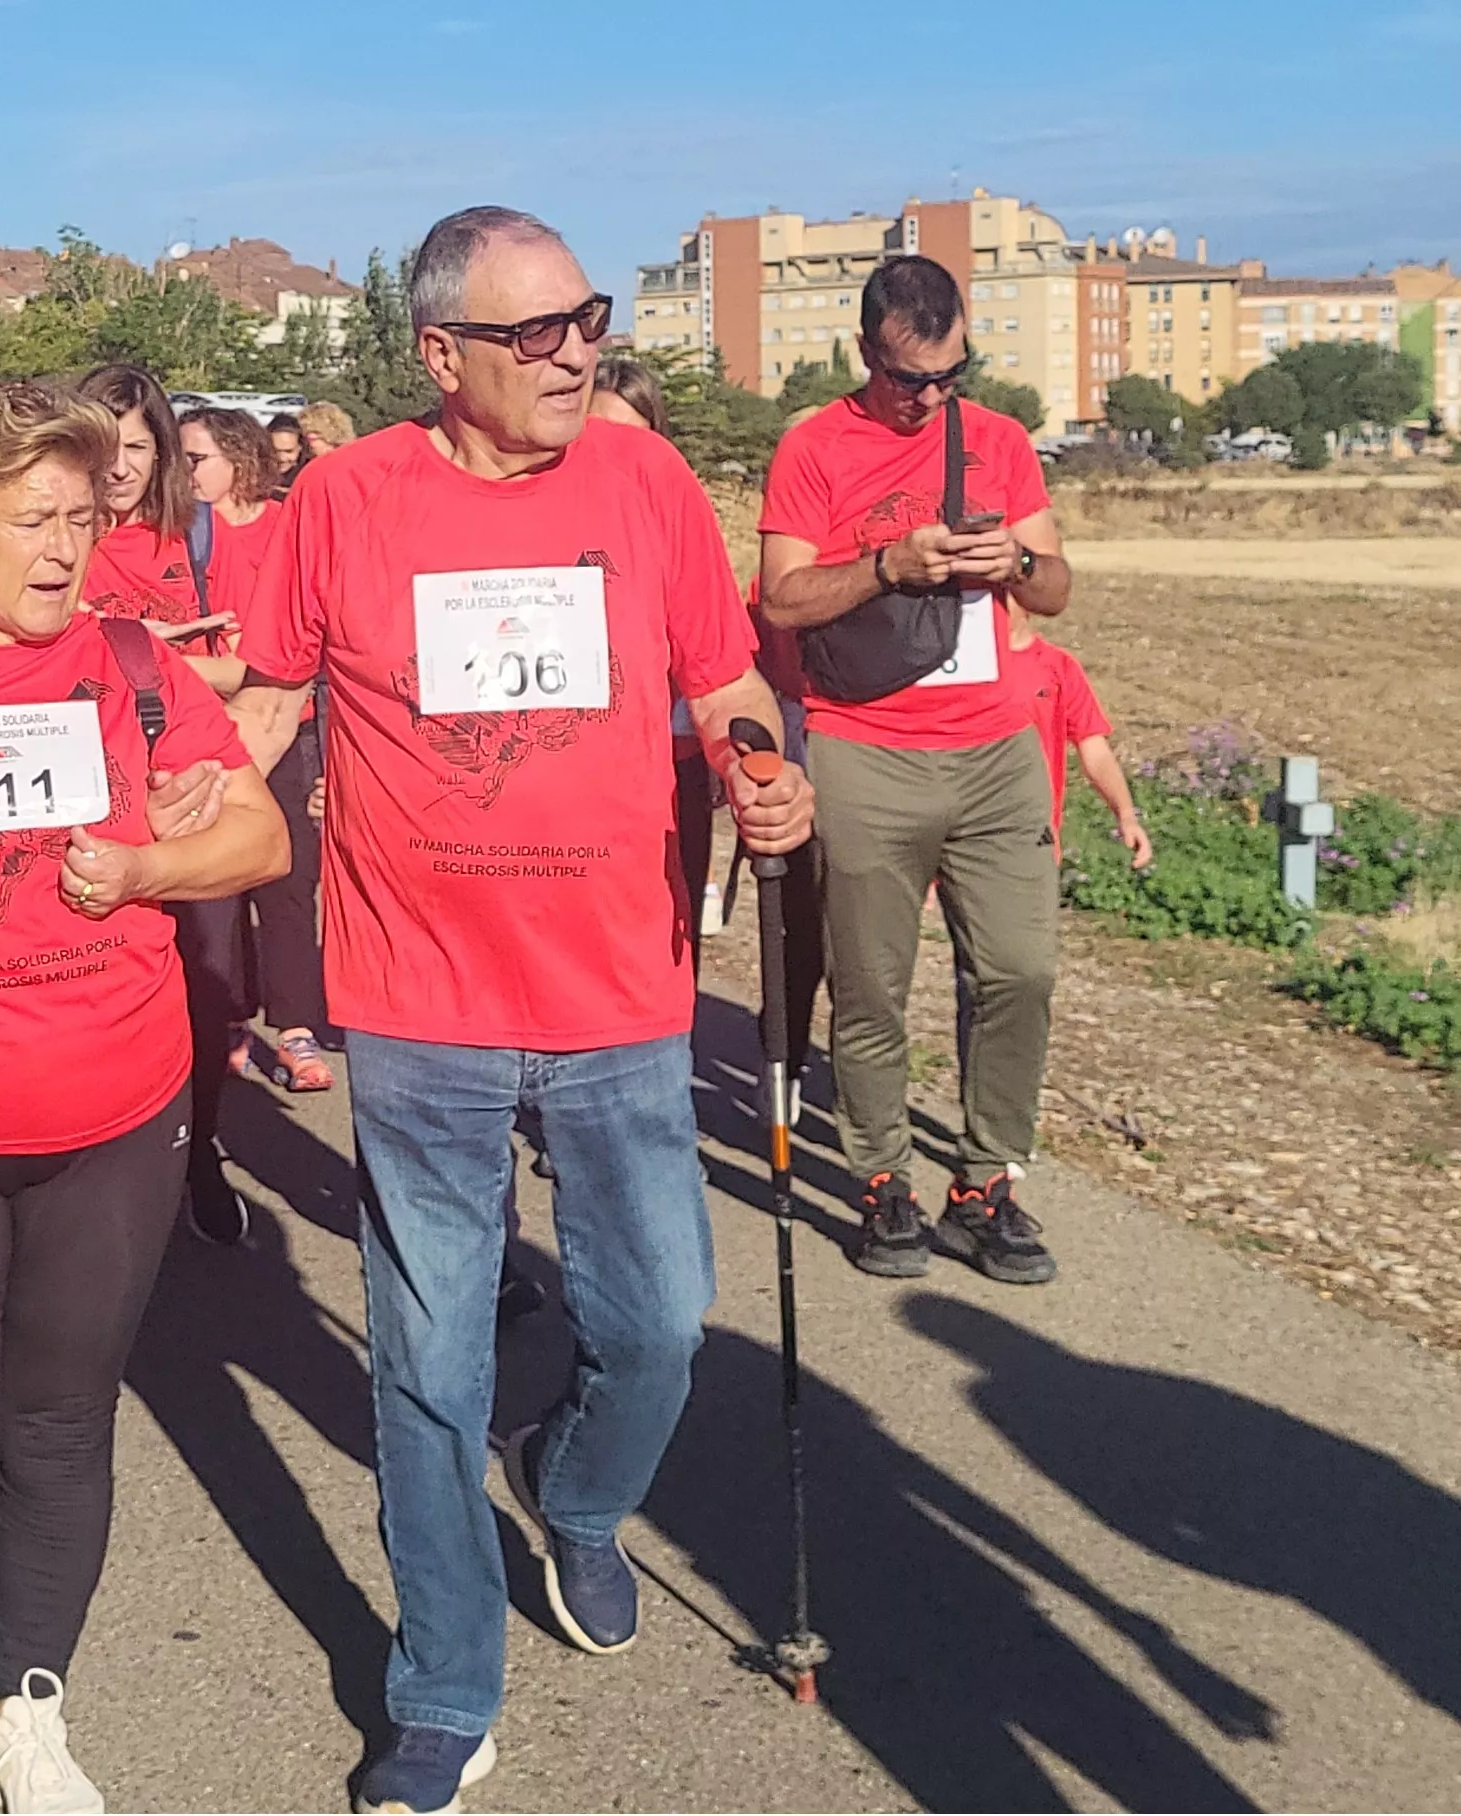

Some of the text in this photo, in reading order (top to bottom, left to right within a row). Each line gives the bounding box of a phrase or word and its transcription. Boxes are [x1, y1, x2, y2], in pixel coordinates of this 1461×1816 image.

[2, 713, 50, 726] SOLIDARIA
[409, 837, 611, 859] IV MARCHA SOLIDARIA POR LA
[433, 861, 587, 878] ESCLEROSIS MULTIPLE
[7, 947, 84, 970] SOLIDARIA
[86, 938, 113, 955] POR
[114, 934, 128, 946] LA
[46, 960, 107, 983] MULTIPLE
